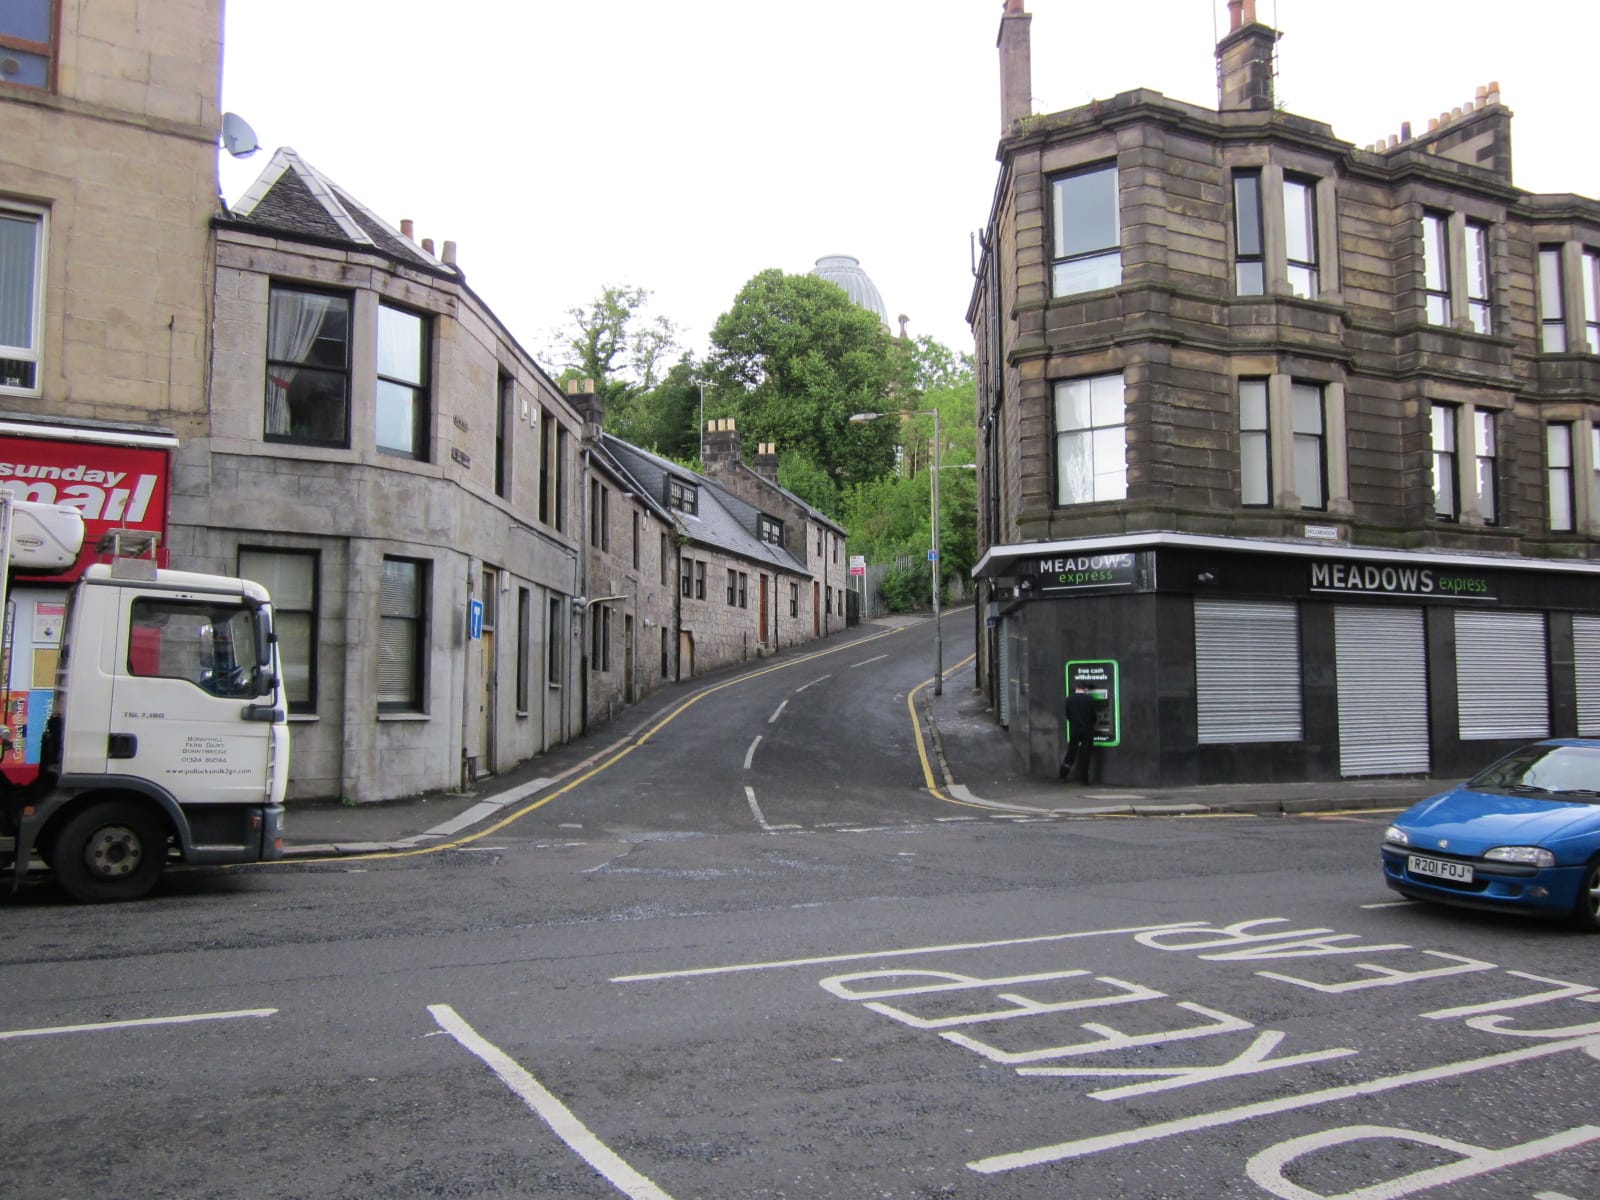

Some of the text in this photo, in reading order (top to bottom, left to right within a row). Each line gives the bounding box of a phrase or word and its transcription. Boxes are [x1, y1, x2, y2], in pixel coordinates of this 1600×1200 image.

[0, 464, 127, 488] sunday
[1040, 553, 1132, 573] MEADOWS
[1059, 570, 1113, 584] express
[1312, 562, 1487, 595] MEADOWS express
[1075, 673, 1108, 681] withdrawals
[12, 696, 25, 760] Confectionery
[1415, 858, 1465, 877] R201 FOJ
